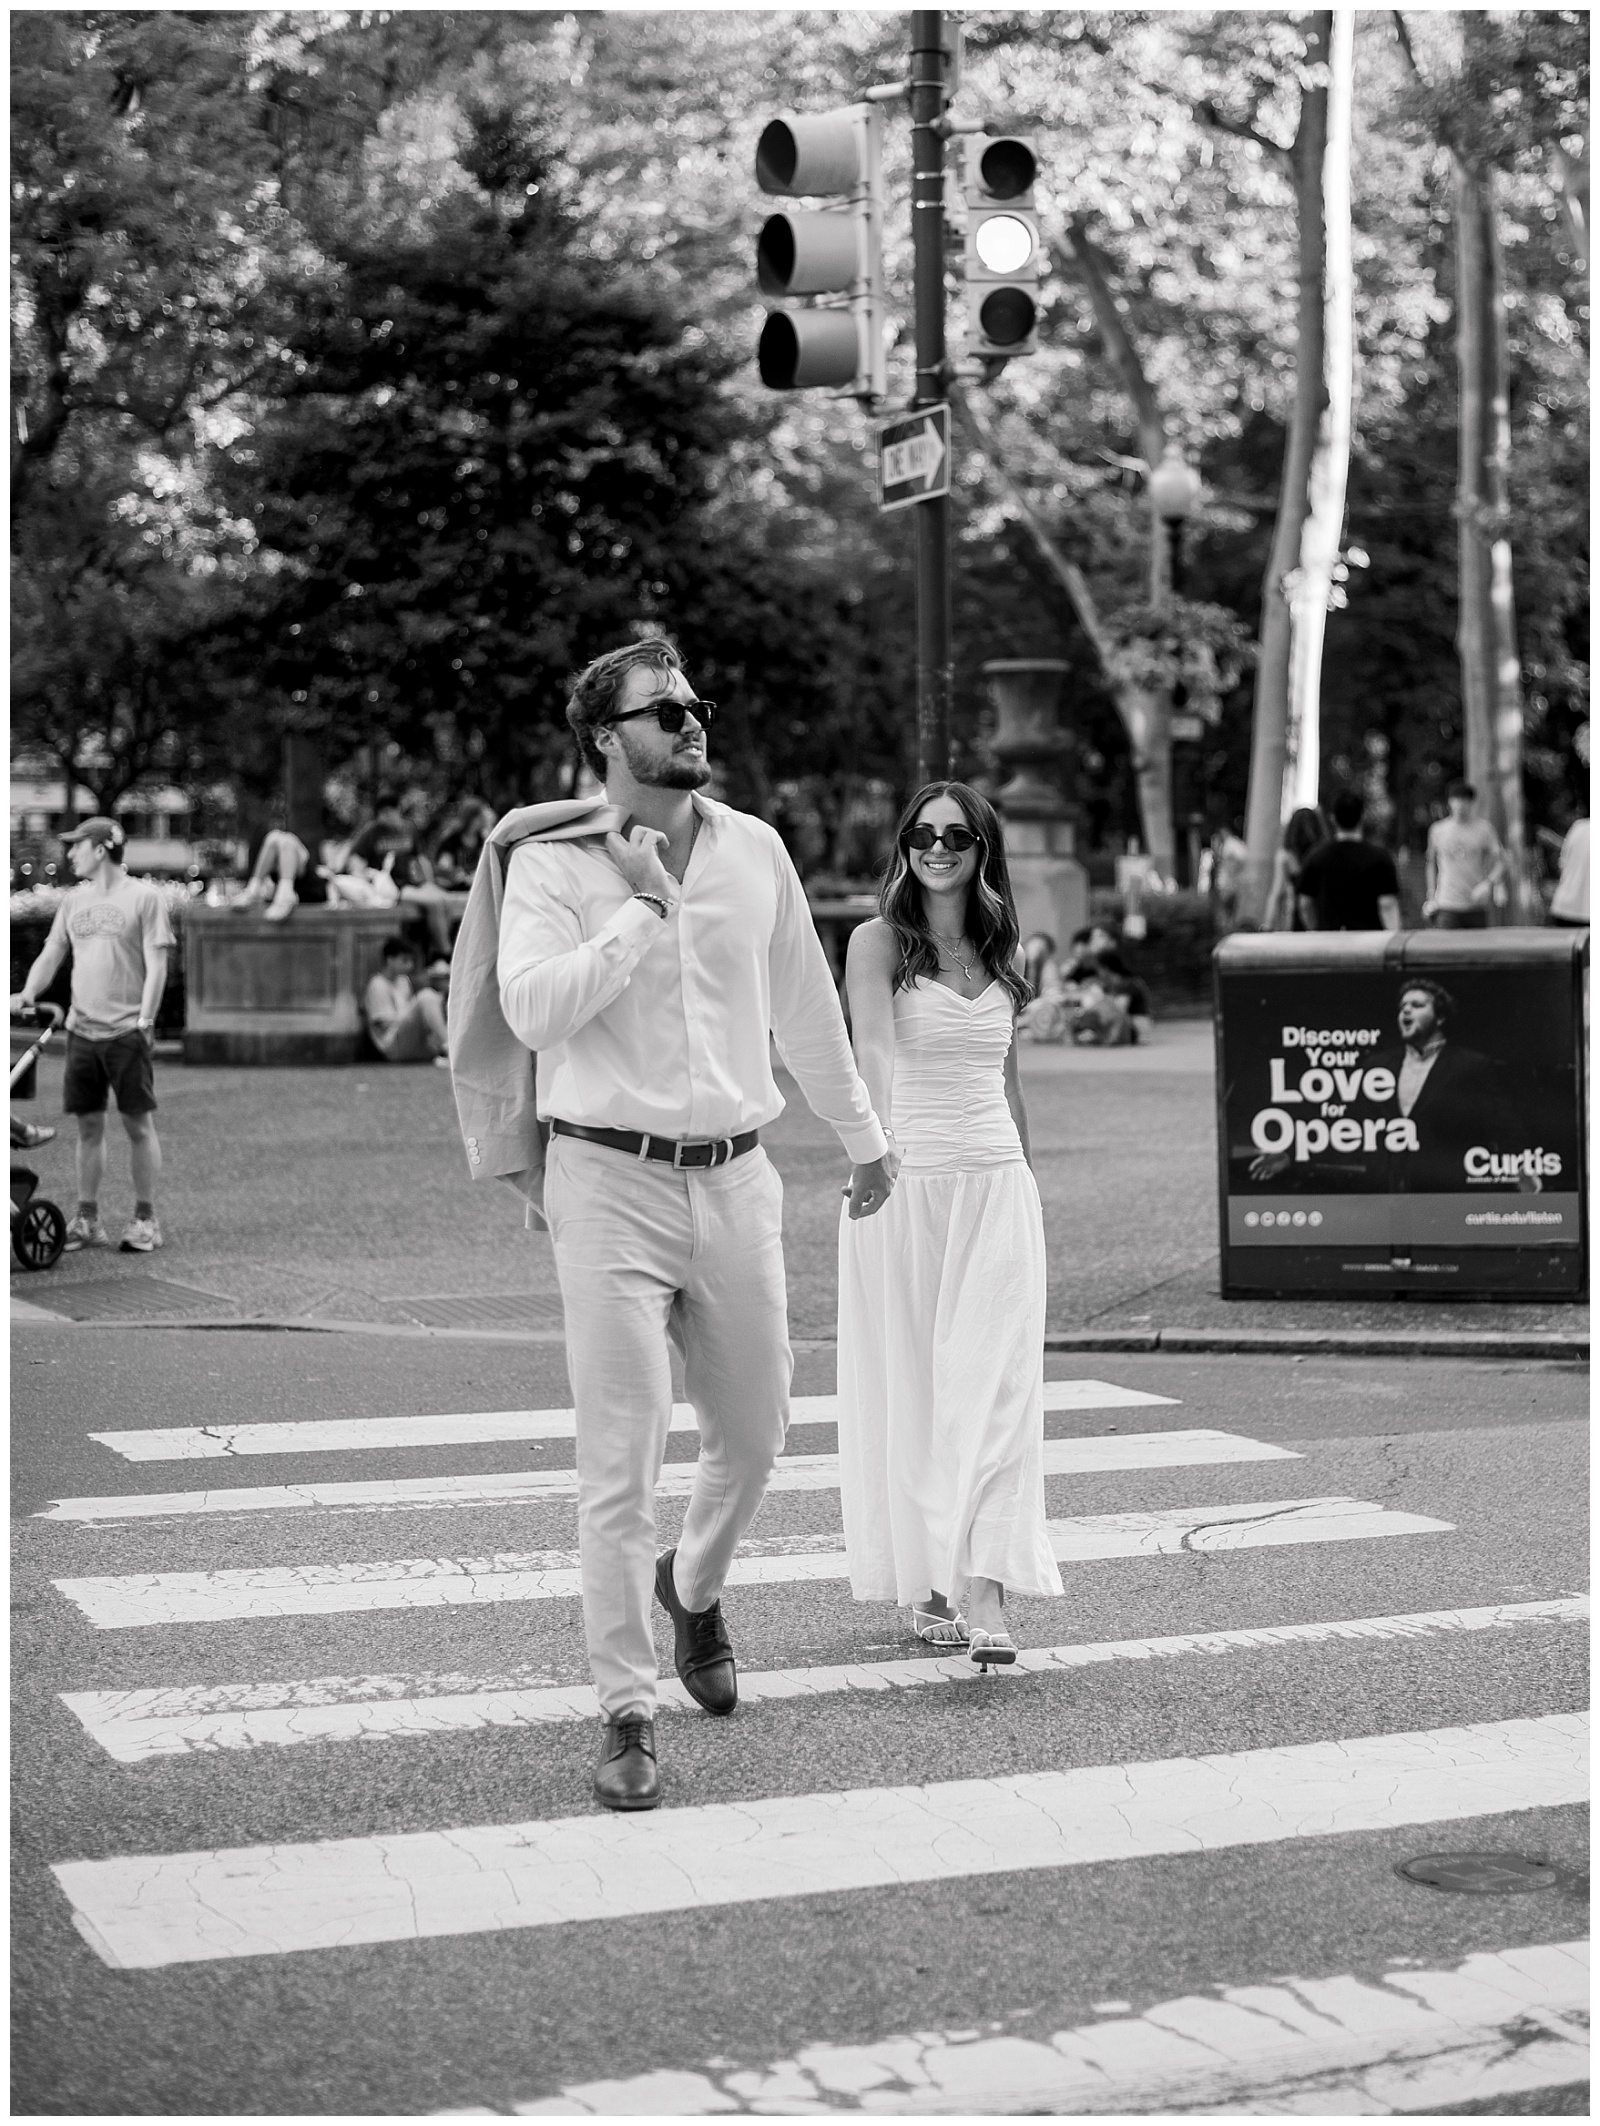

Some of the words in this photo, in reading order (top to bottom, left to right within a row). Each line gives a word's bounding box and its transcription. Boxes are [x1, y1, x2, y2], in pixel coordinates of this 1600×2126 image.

[1282, 1026, 1381, 1047] Discover
[1305, 1047, 1360, 1068] Your
[1269, 1057, 1397, 1103] Love
[1320, 1101, 1347, 1118] for
[1250, 1107, 1420, 1162] Opera
